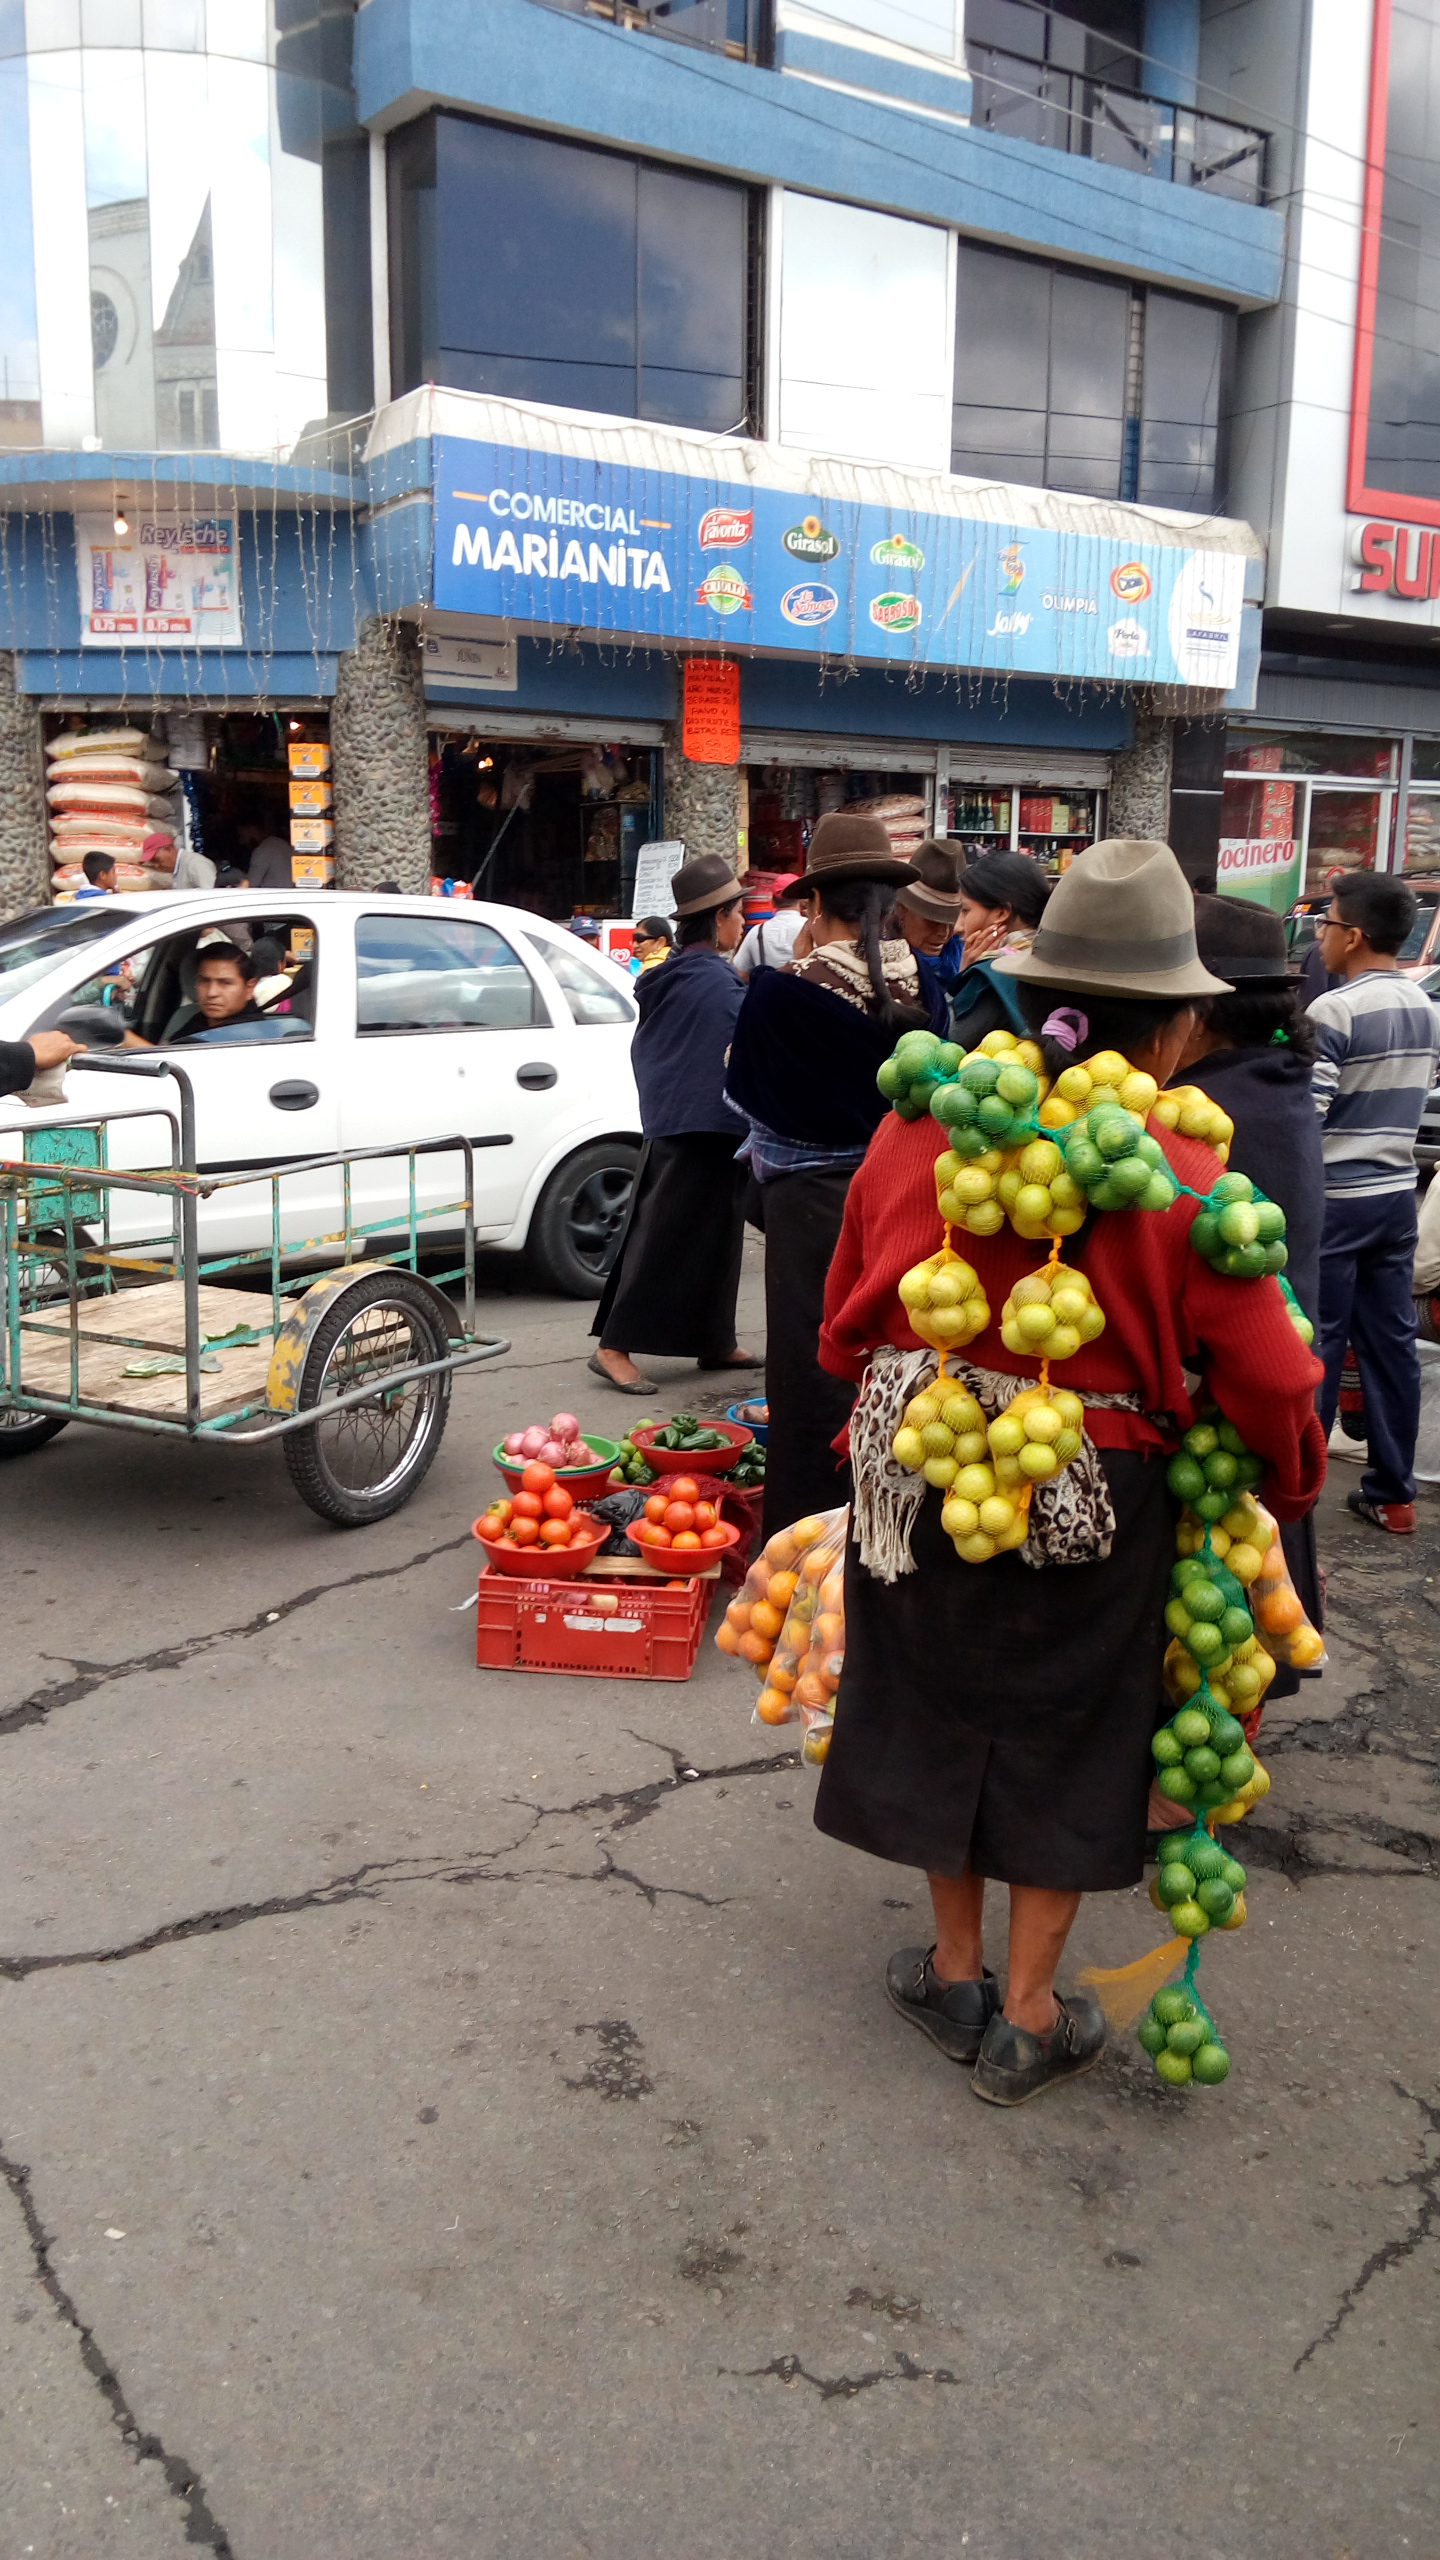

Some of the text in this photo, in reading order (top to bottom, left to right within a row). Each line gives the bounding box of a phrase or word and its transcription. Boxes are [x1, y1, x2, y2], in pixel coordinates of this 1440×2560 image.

[488, 489, 640, 535] COMERCIAL
[703, 519, 746, 543] Favorita
[787, 532, 834, 555] Girasol
[1042, 594, 1098, 616] OLIMPIA
[1218, 840, 1295, 869] ocinero
